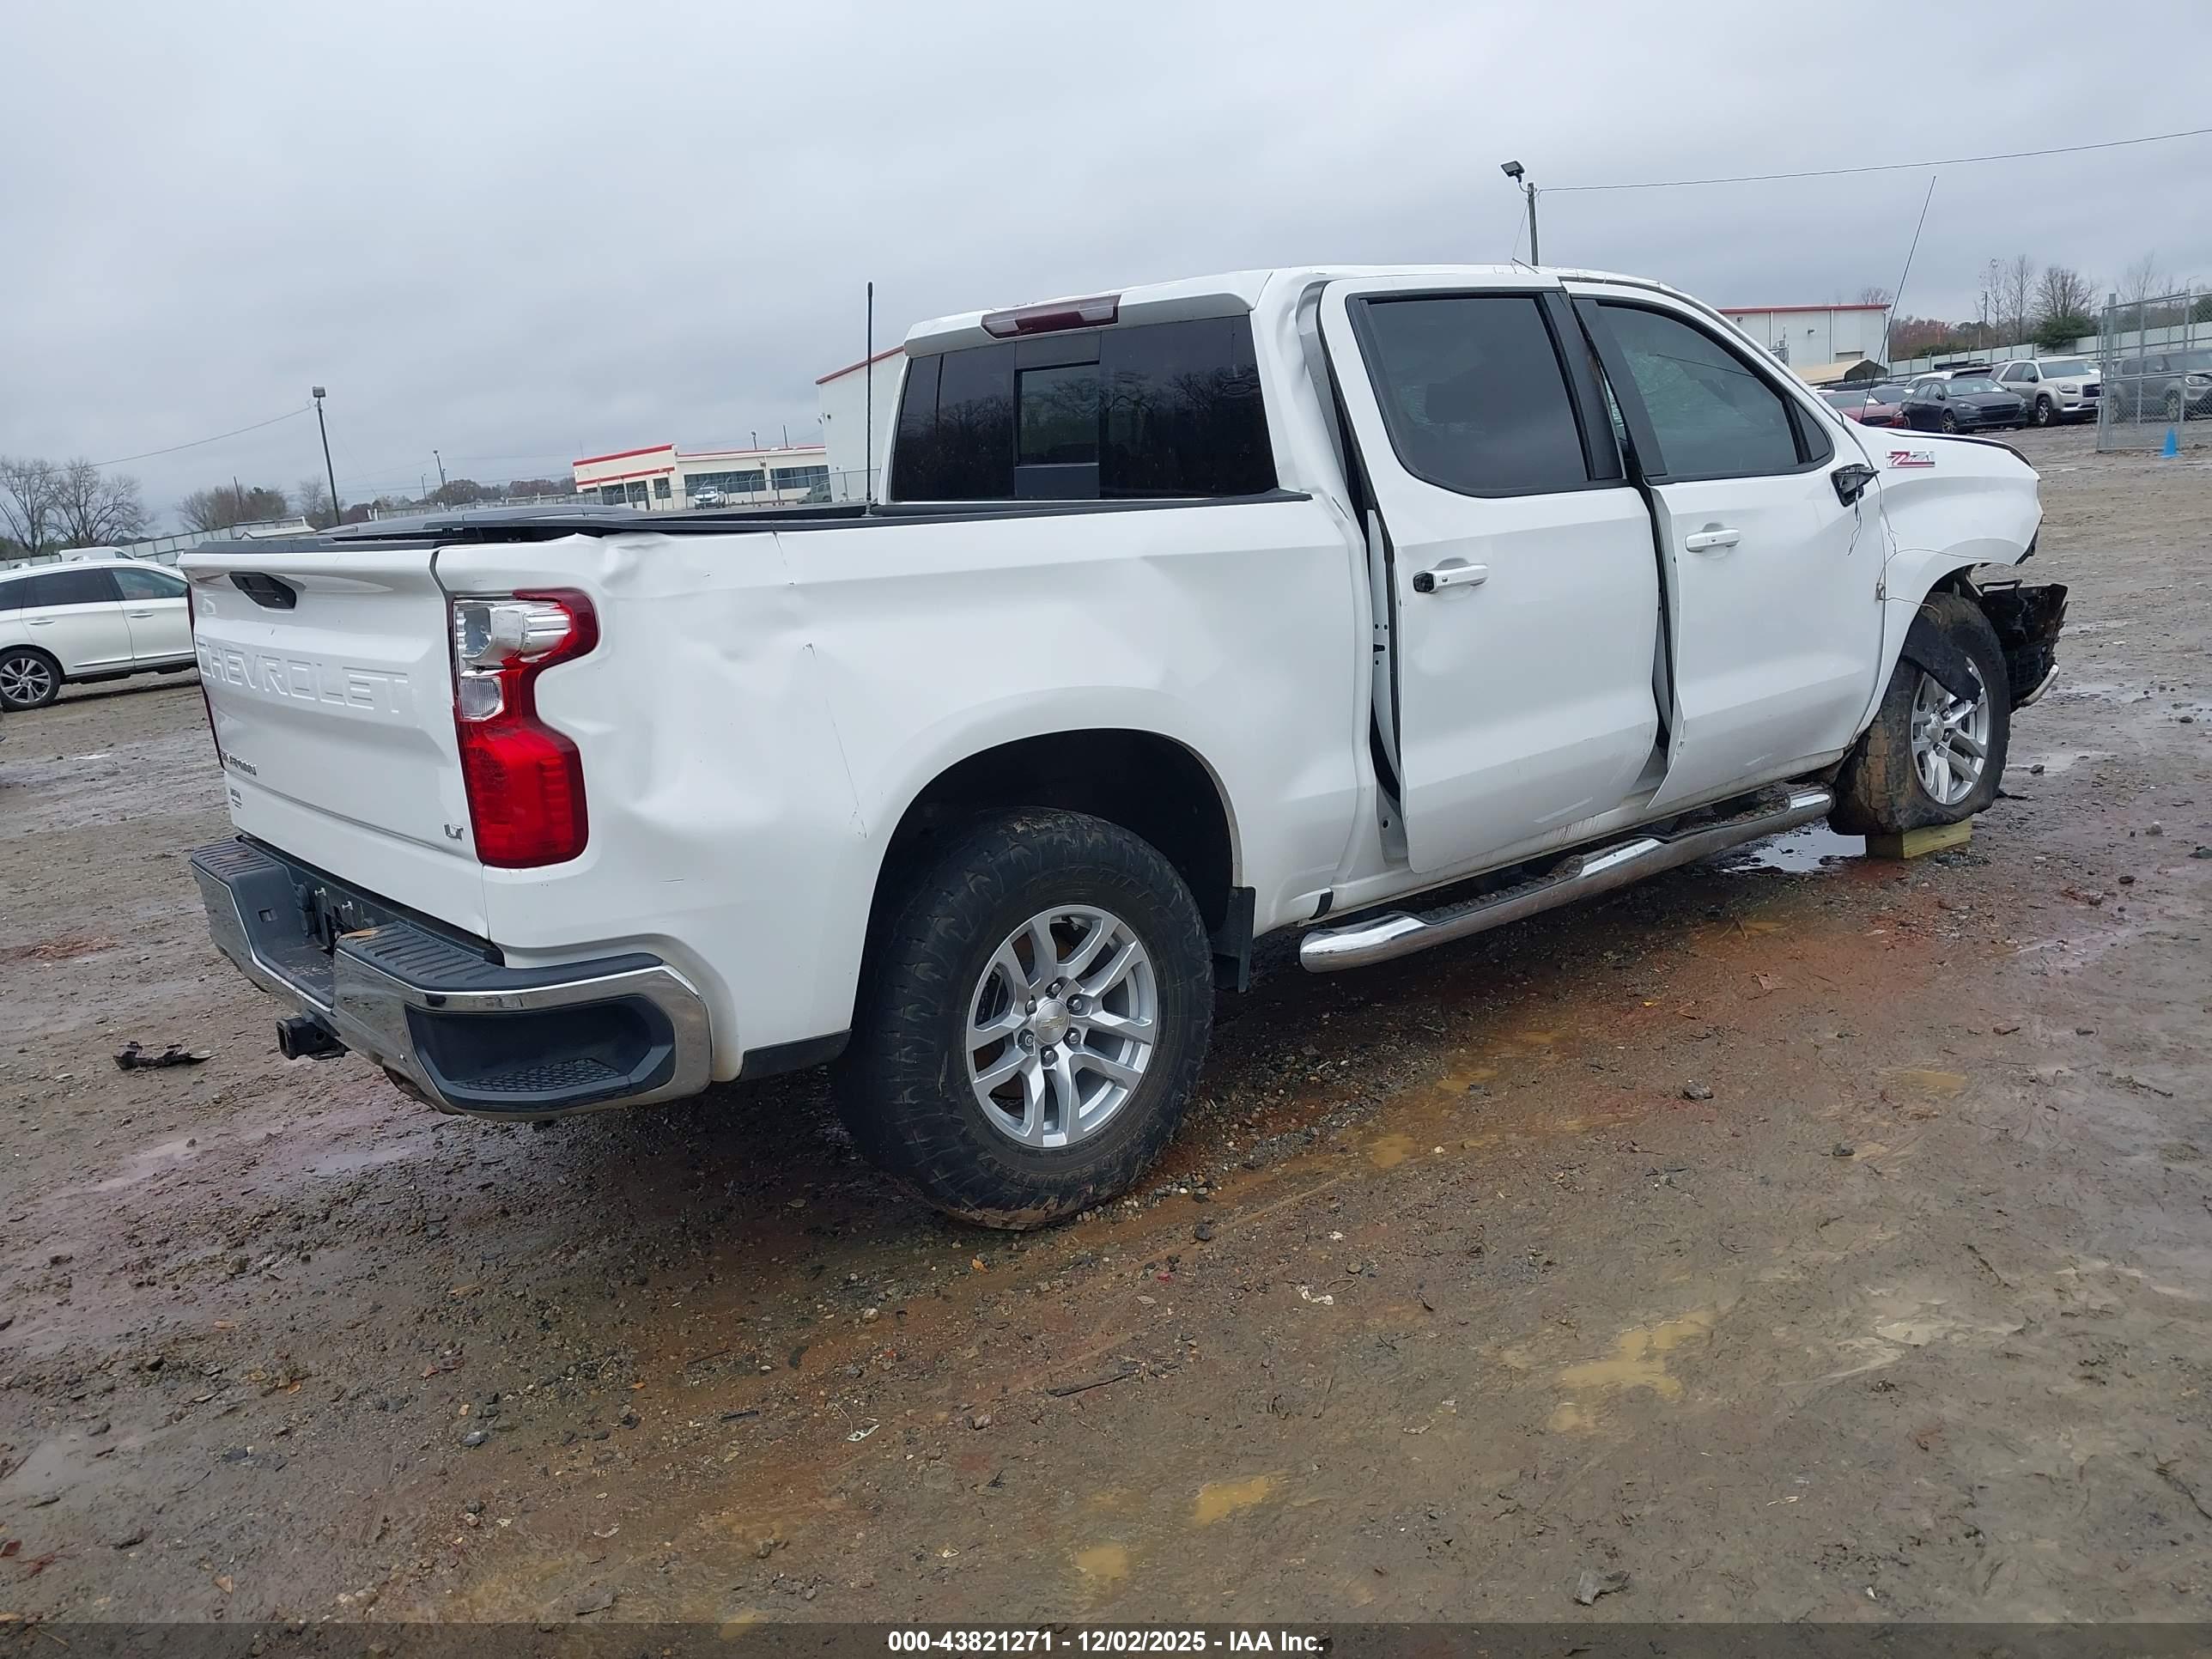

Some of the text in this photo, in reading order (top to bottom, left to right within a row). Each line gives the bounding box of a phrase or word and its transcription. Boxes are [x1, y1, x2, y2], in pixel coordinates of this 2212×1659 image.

[1887, 450, 1936, 469] Z71
[194, 642, 409, 714] CHEVROLET
[443, 823, 464, 842] LT
